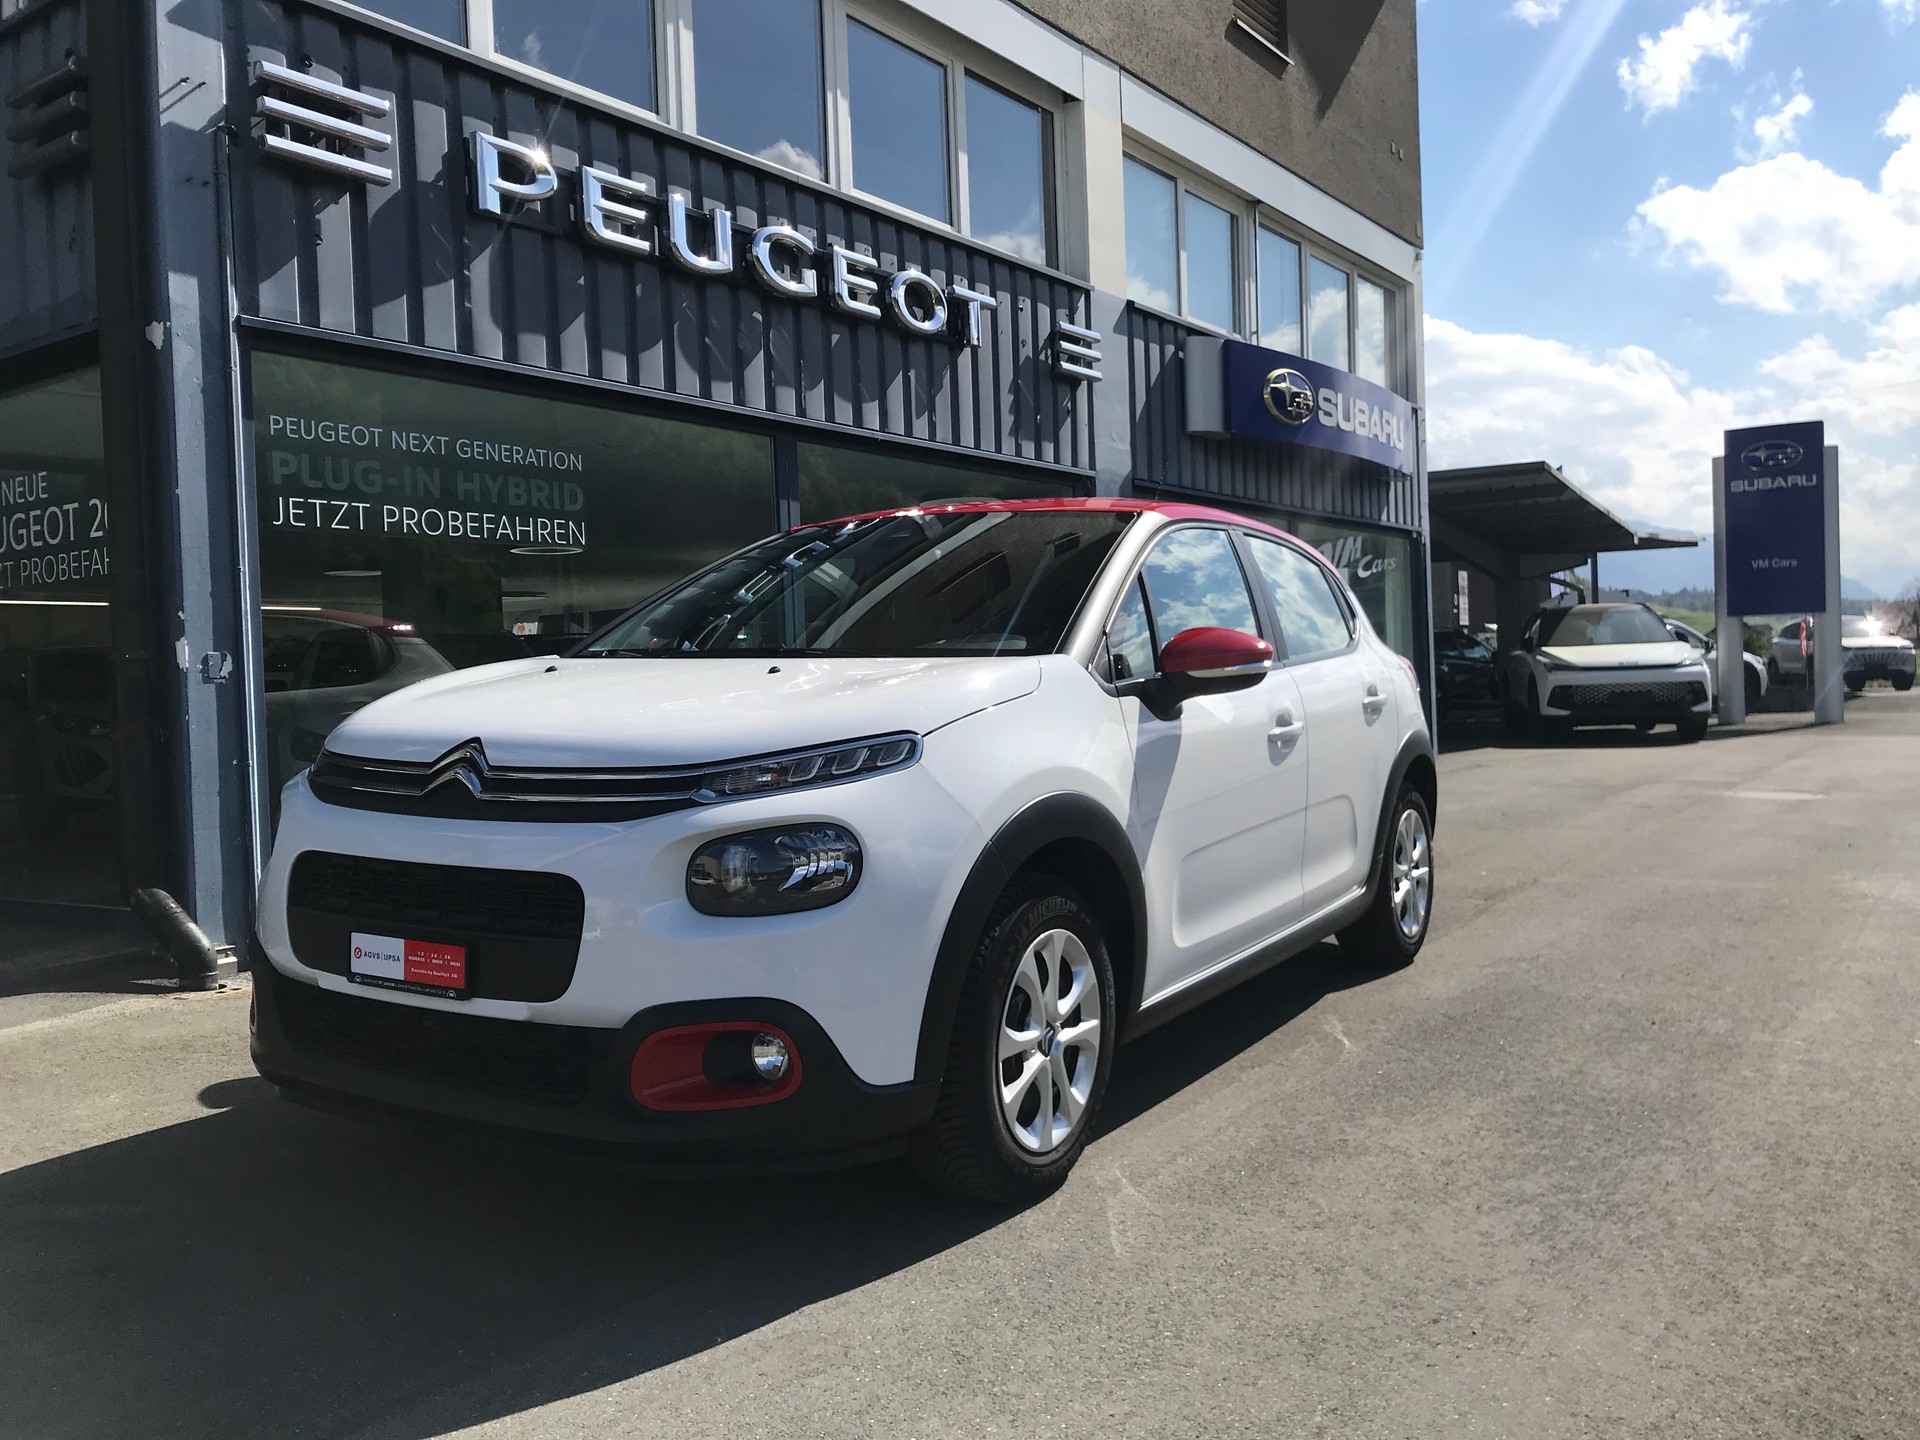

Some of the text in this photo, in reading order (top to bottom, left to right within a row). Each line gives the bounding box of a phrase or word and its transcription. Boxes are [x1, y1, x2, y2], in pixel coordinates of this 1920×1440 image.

[469, 131, 997, 349] PEUGEOT
[1318, 388, 1405, 450] SUBARU
[269, 415, 583, 471] PEUGEOT NEXT GENERATION
[1, 471, 49, 506] NEUE
[271, 450, 585, 512] PLUG-IN HYBRID
[1730, 474, 1817, 493] SUBARU
[88, 498, 109, 538] 2
[273, 496, 586, 546] JETZT PROBEFAHREN
[1357, 554, 1396, 578] Cars
[1751, 558, 1798, 570] VM Cars
[1028, 897, 1078, 927] MICHELIN
